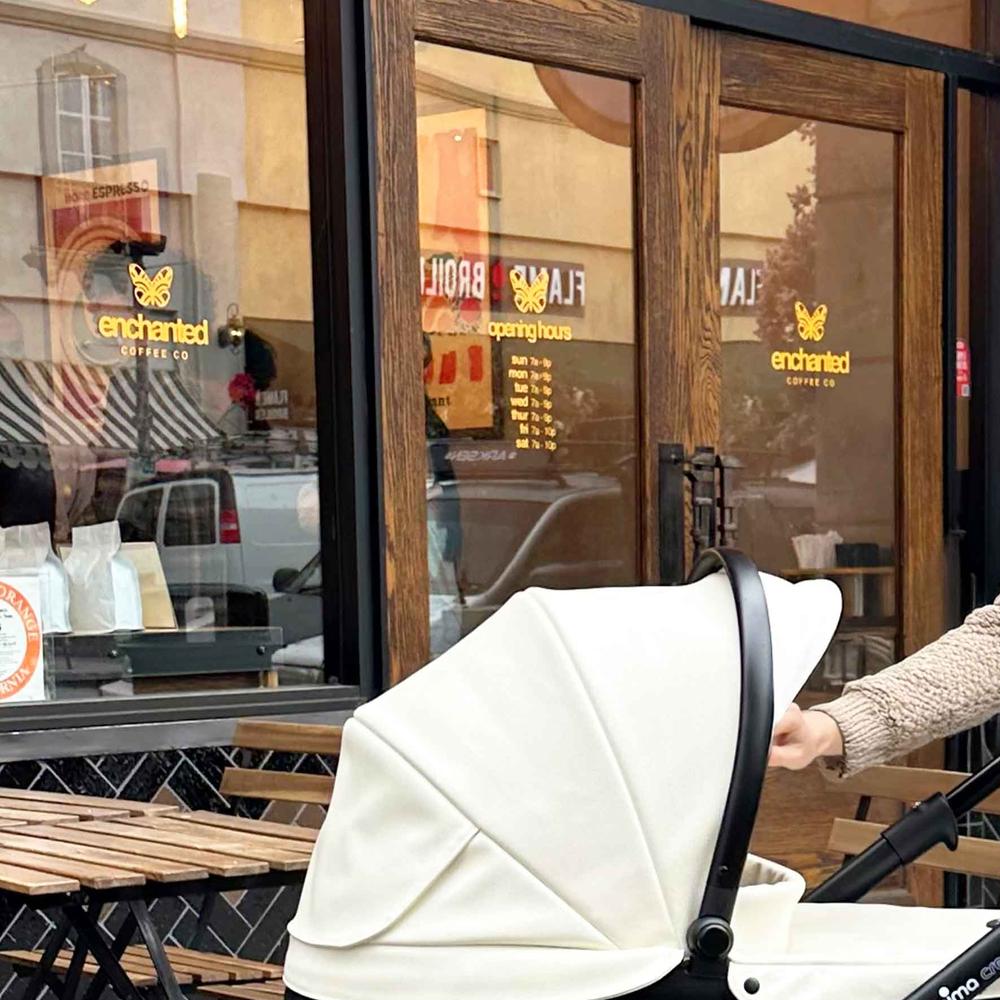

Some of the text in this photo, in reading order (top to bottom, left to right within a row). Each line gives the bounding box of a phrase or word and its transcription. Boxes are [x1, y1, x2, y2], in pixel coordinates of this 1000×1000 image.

[98, 313, 209, 345] enchanted
[488, 319, 572, 343] opening hours
[120, 345, 189, 361] COFFEE CO
[771, 347, 850, 374] enchanted
[786, 376, 836, 388] COFFEE CO
